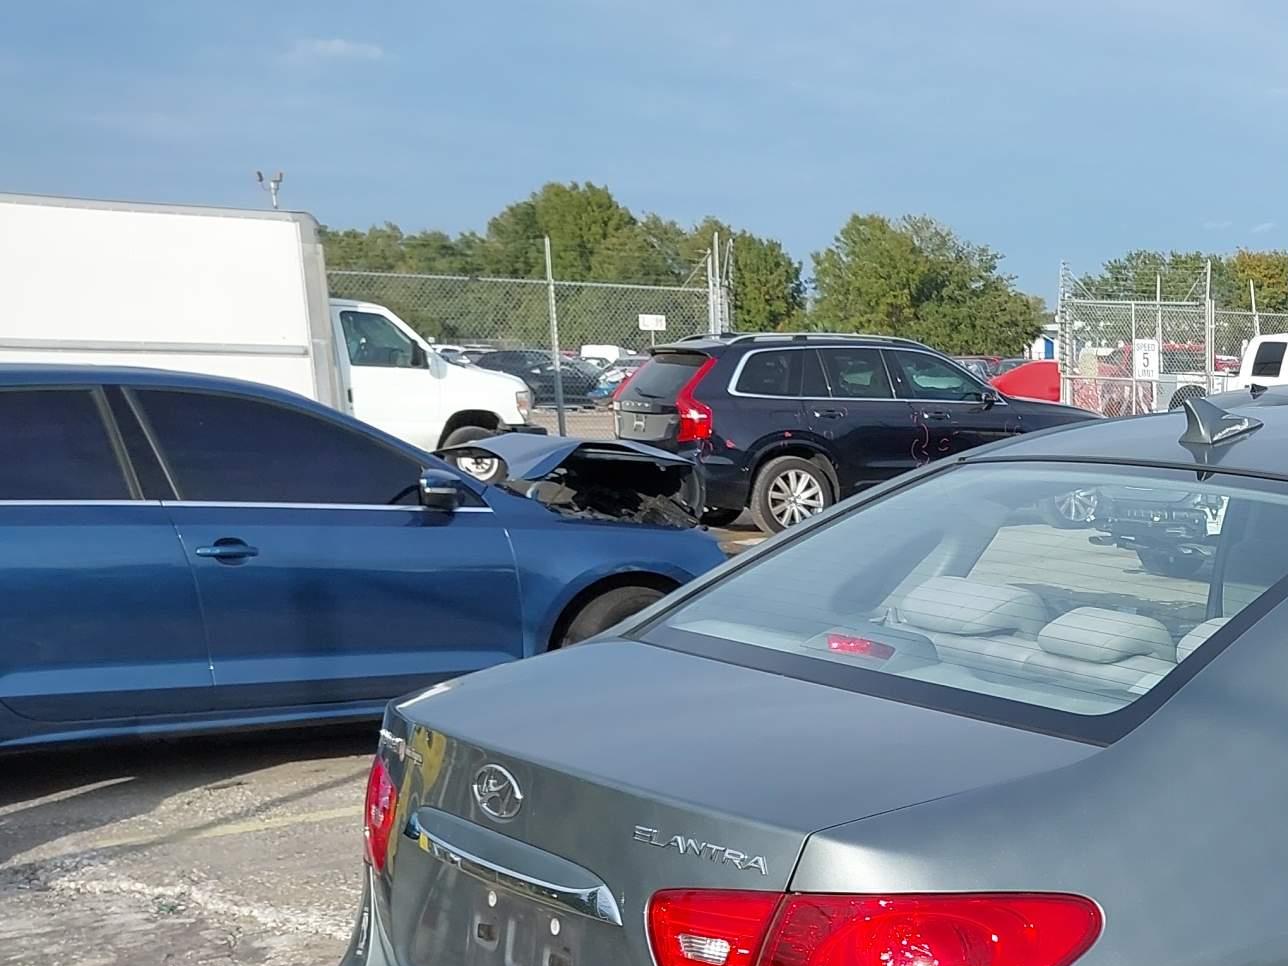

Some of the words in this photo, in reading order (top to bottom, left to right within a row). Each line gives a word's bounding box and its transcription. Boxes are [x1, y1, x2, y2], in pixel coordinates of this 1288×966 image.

[1135, 342, 1156, 352] SPEED
[1141, 352, 1151, 368] 5
[1137, 368, 1155, 378] LIMIT
[632, 824, 769, 875] ELANTRA
